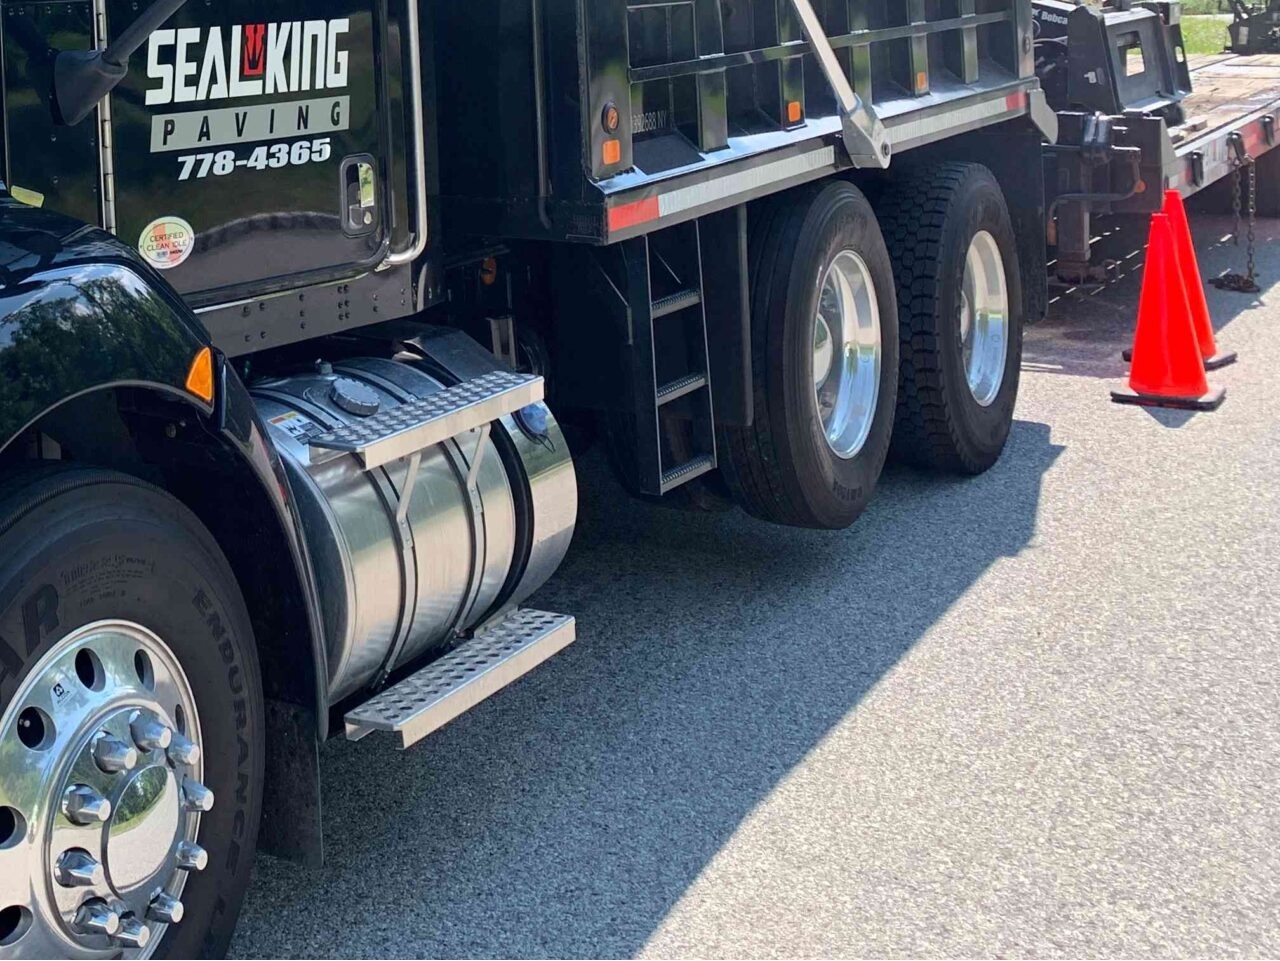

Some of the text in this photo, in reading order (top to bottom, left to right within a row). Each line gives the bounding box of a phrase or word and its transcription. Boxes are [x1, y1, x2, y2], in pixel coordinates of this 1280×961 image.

[1040, 11, 1068, 25] Bobca
[162, 101, 341, 146] PAVING
[177, 137, 332, 181] 778-4365
[146, 242, 170, 252] CLEAN
[173, 240, 187, 248] IDLE
[149, 231, 184, 243] CERTIFIED
[191, 587, 248, 876] ENDURANCE
